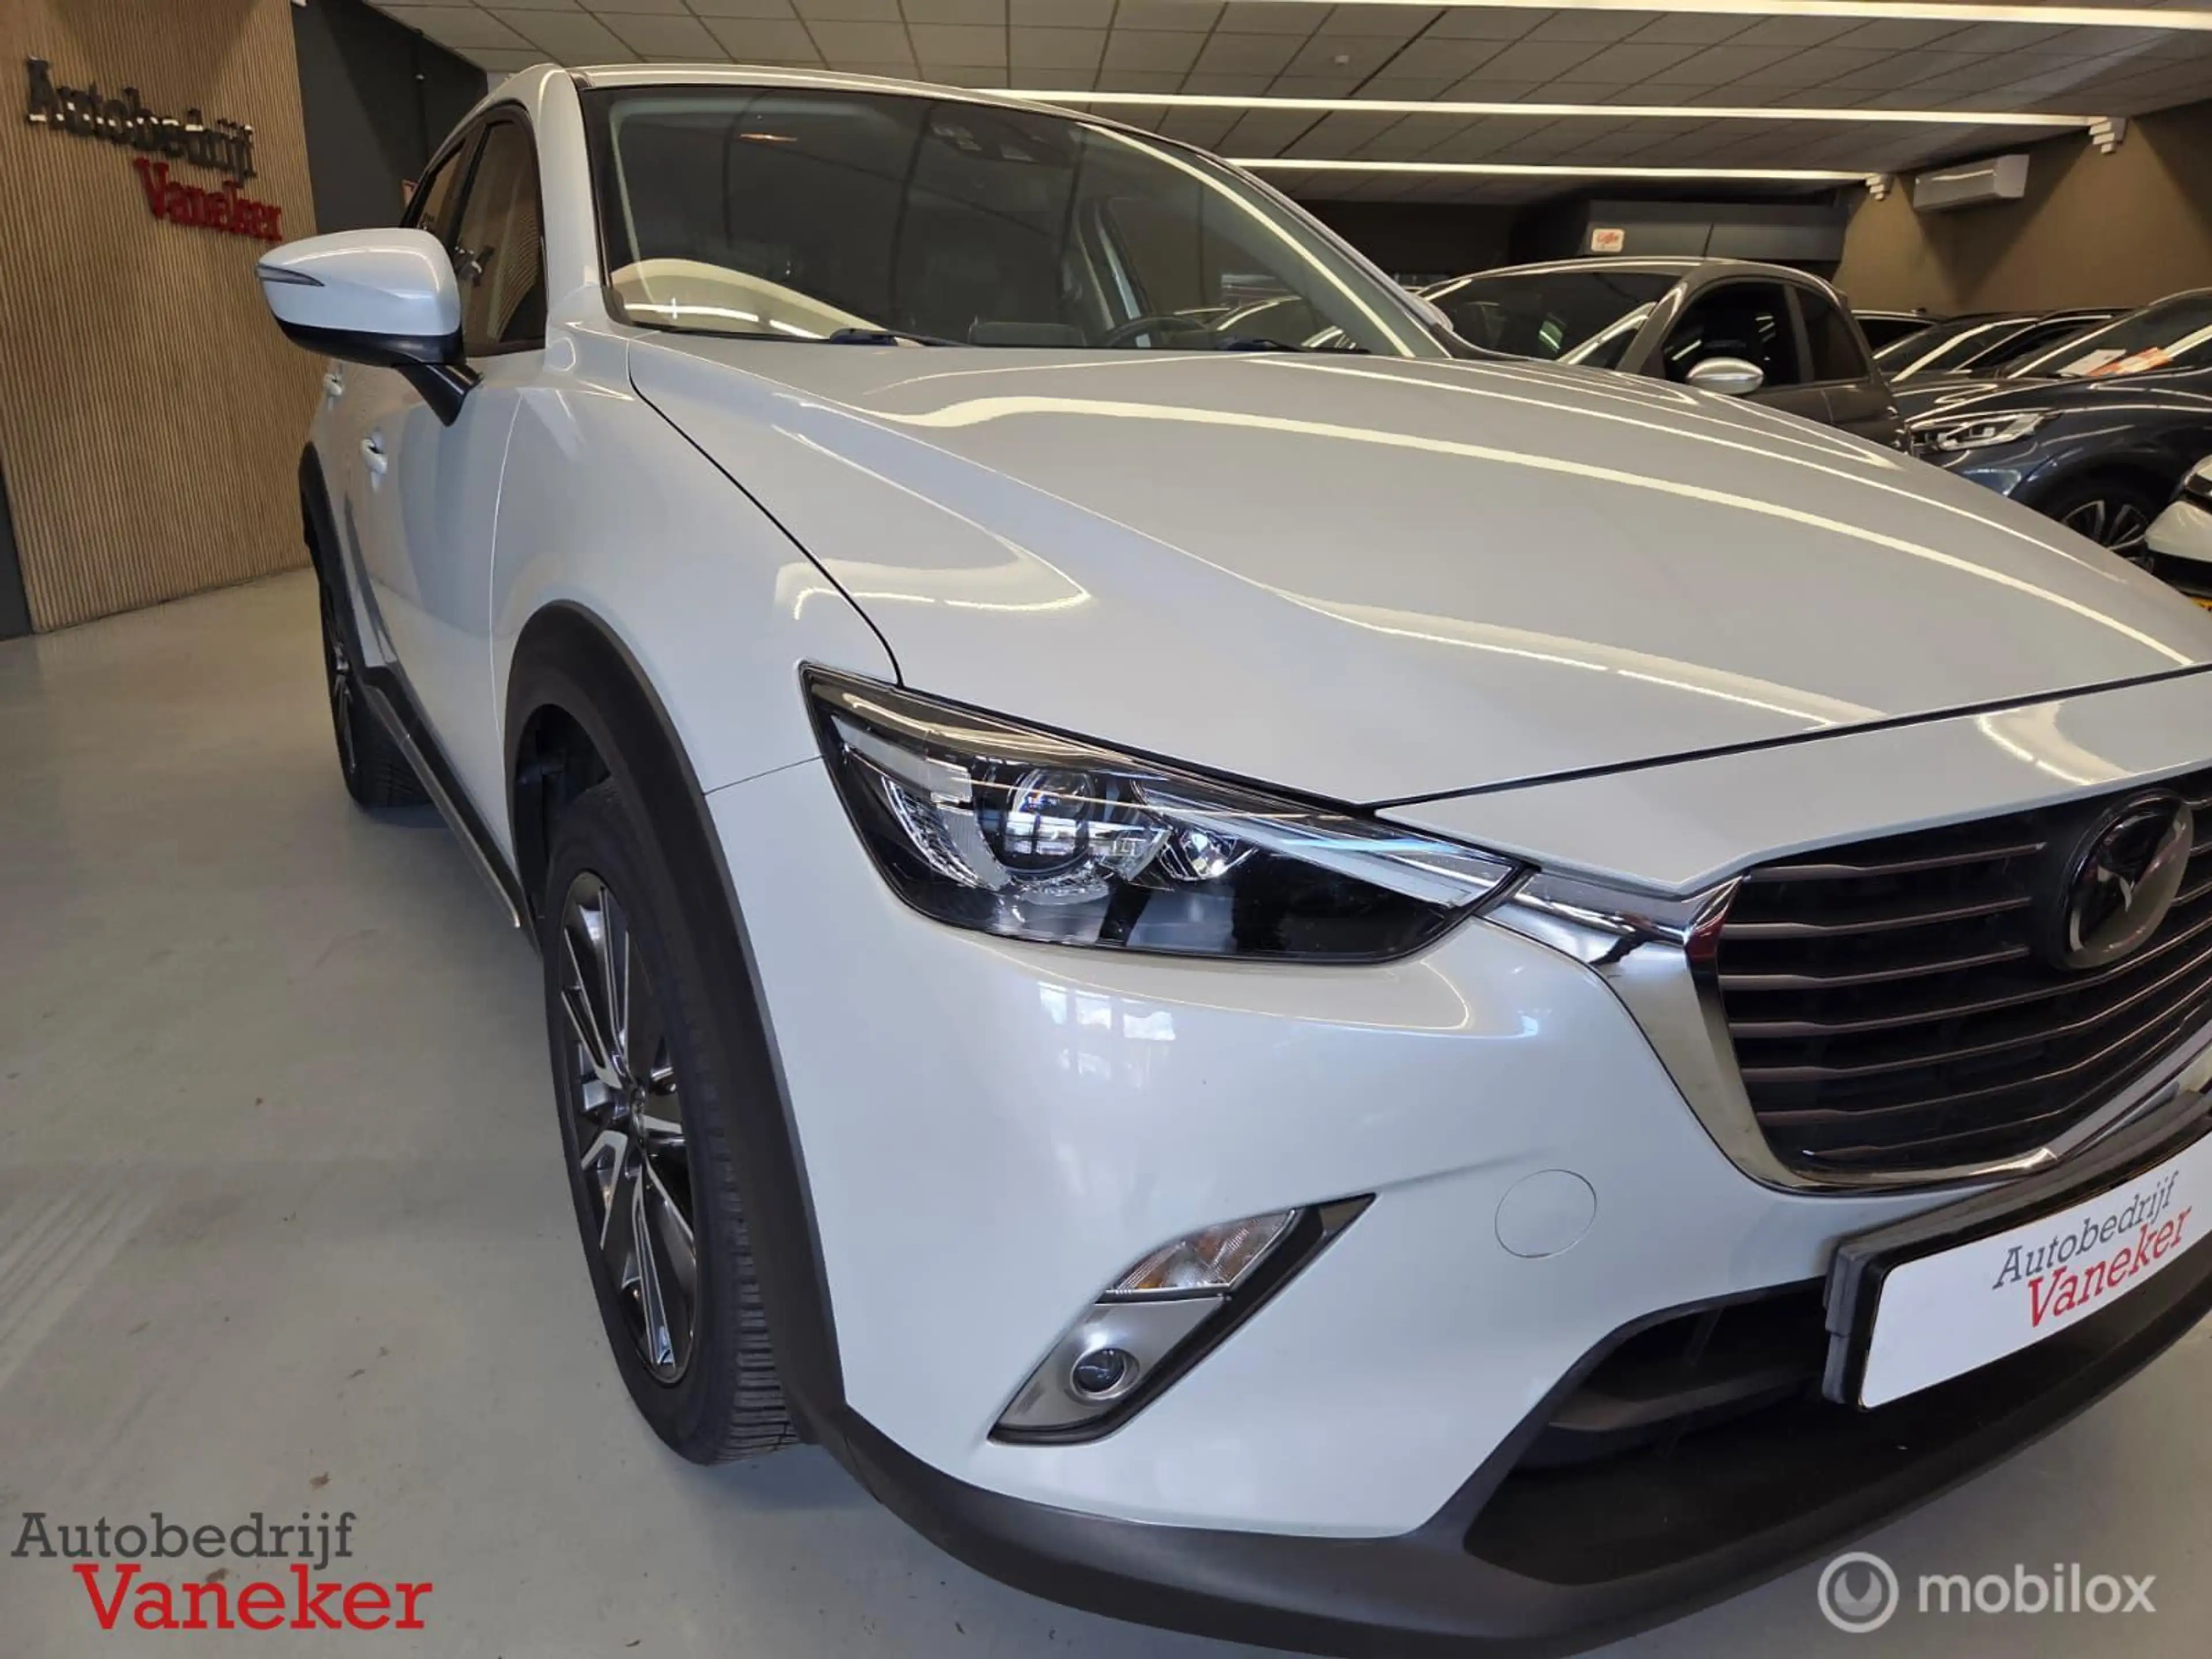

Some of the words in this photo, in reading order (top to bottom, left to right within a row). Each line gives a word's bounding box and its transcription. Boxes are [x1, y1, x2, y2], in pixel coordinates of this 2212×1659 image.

[133, 156, 282, 242] Vaneker
[1992, 1169, 2179, 1289] Autobedrijf
[2027, 1206, 2192, 1328] Vaneker
